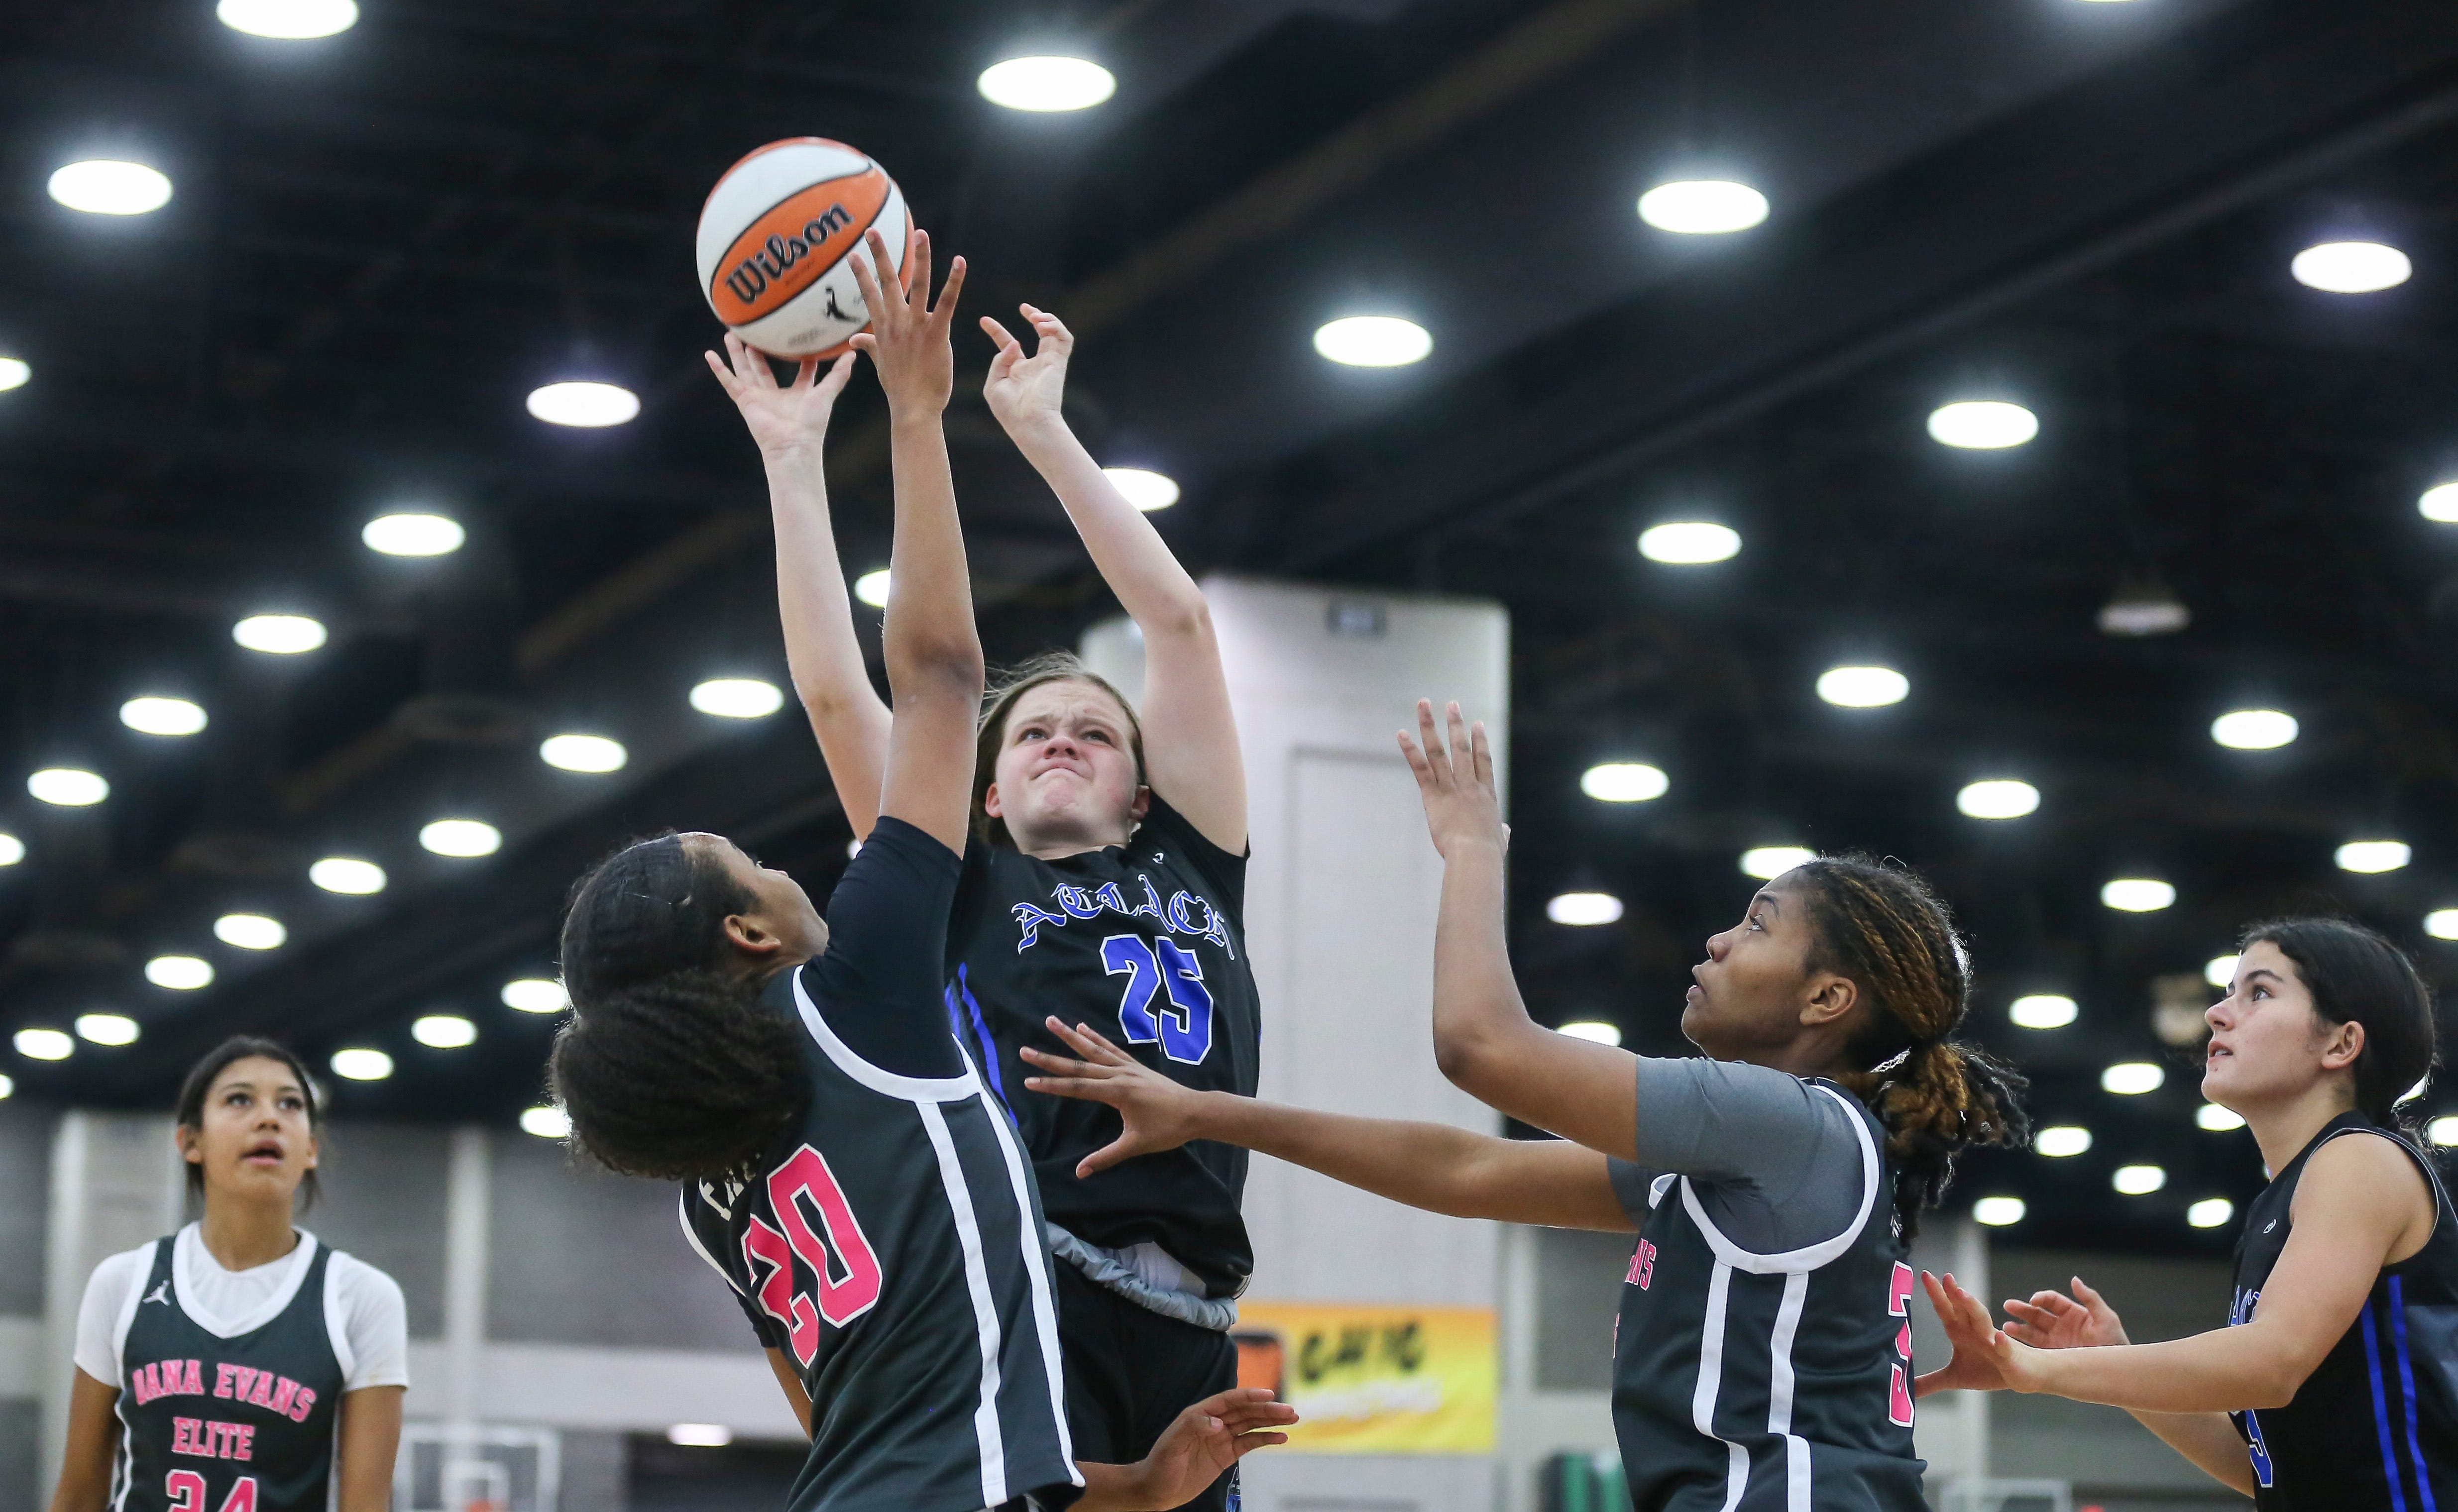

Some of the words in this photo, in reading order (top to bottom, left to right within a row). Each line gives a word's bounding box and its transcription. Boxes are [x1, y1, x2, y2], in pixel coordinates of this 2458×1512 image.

[724, 202, 855, 305] Wilson
[1099, 934, 1214, 1065] 25
[740, 1143, 883, 1369] 20
[132, 1359, 205, 1406] DANA
[213, 1362, 317, 1423] EVANS
[171, 1416, 255, 1461] ELITE
